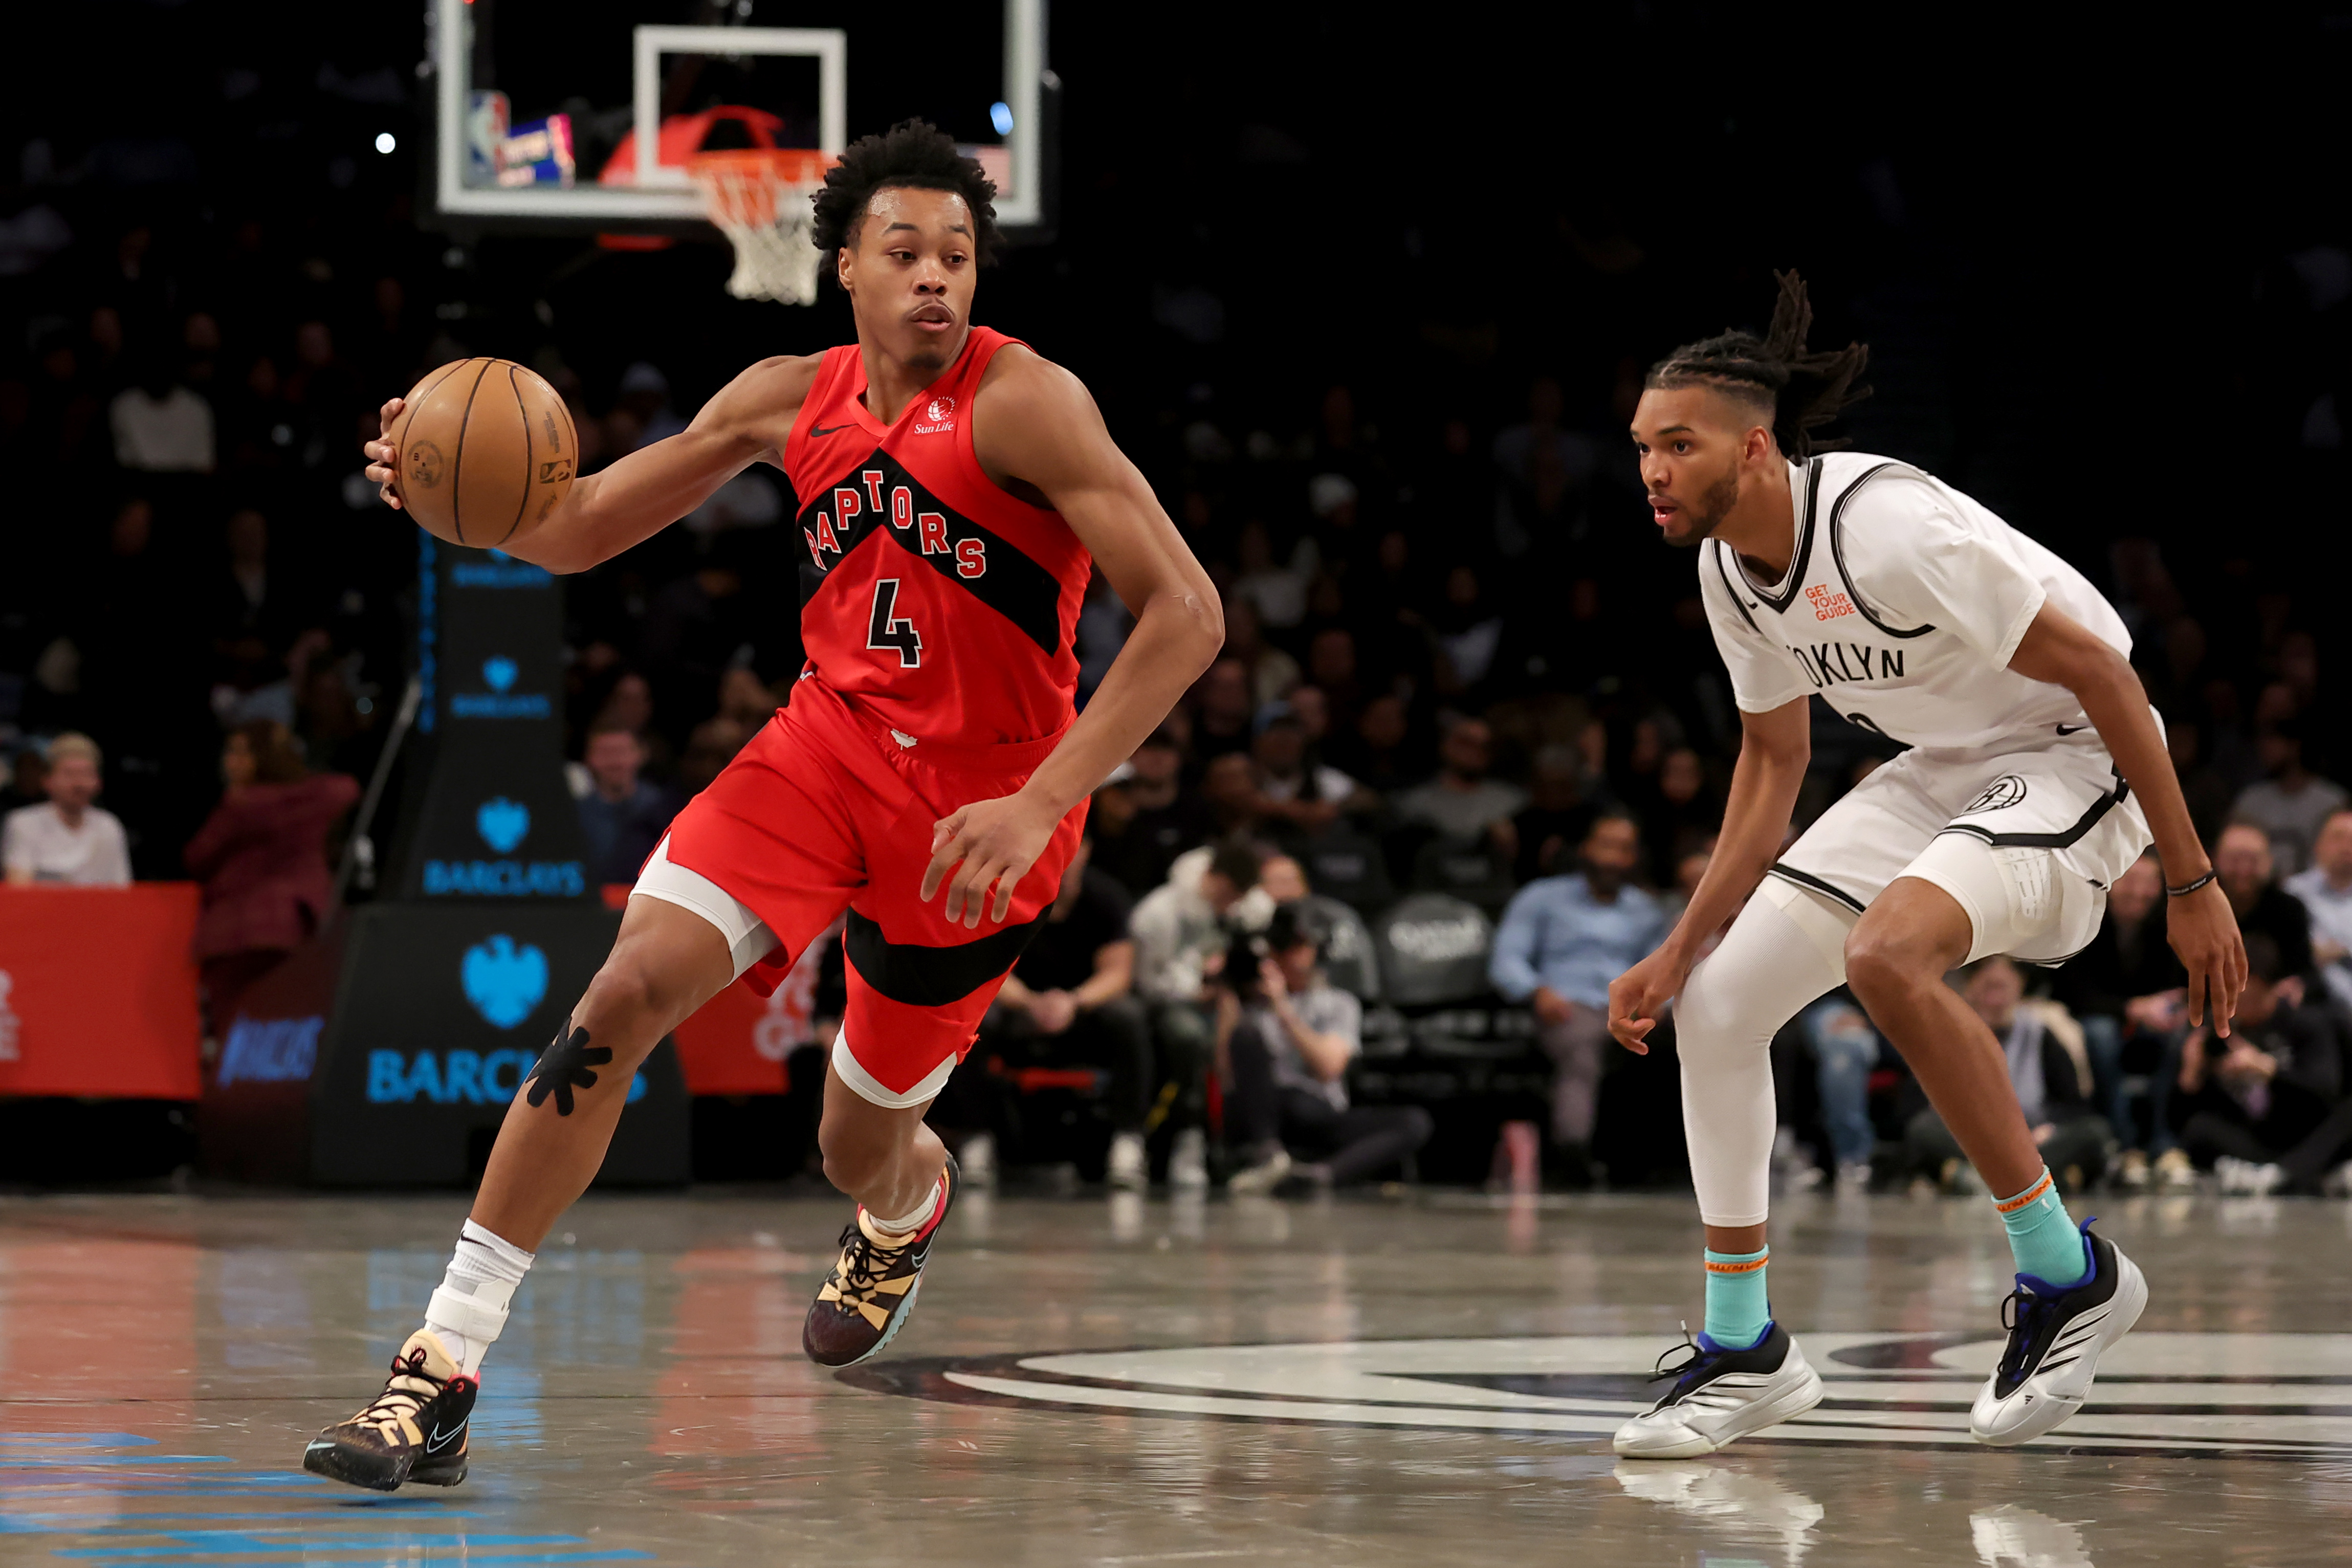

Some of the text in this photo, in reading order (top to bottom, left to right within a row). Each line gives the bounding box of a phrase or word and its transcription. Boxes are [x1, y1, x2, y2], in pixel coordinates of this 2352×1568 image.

[914, 421, 954, 434] Sun Life
[803, 470, 986, 579] RAPTORS
[1805, 584, 1829, 599] GET
[1810, 592, 1848, 610] YOUR
[866, 578, 923, 669] 4
[1815, 603, 1856, 622] GUIDE
[1786, 642, 1904, 688] OKLYN
[423, 860, 584, 896] BARCLAYS
[367, 1049, 648, 1103] BARCS
